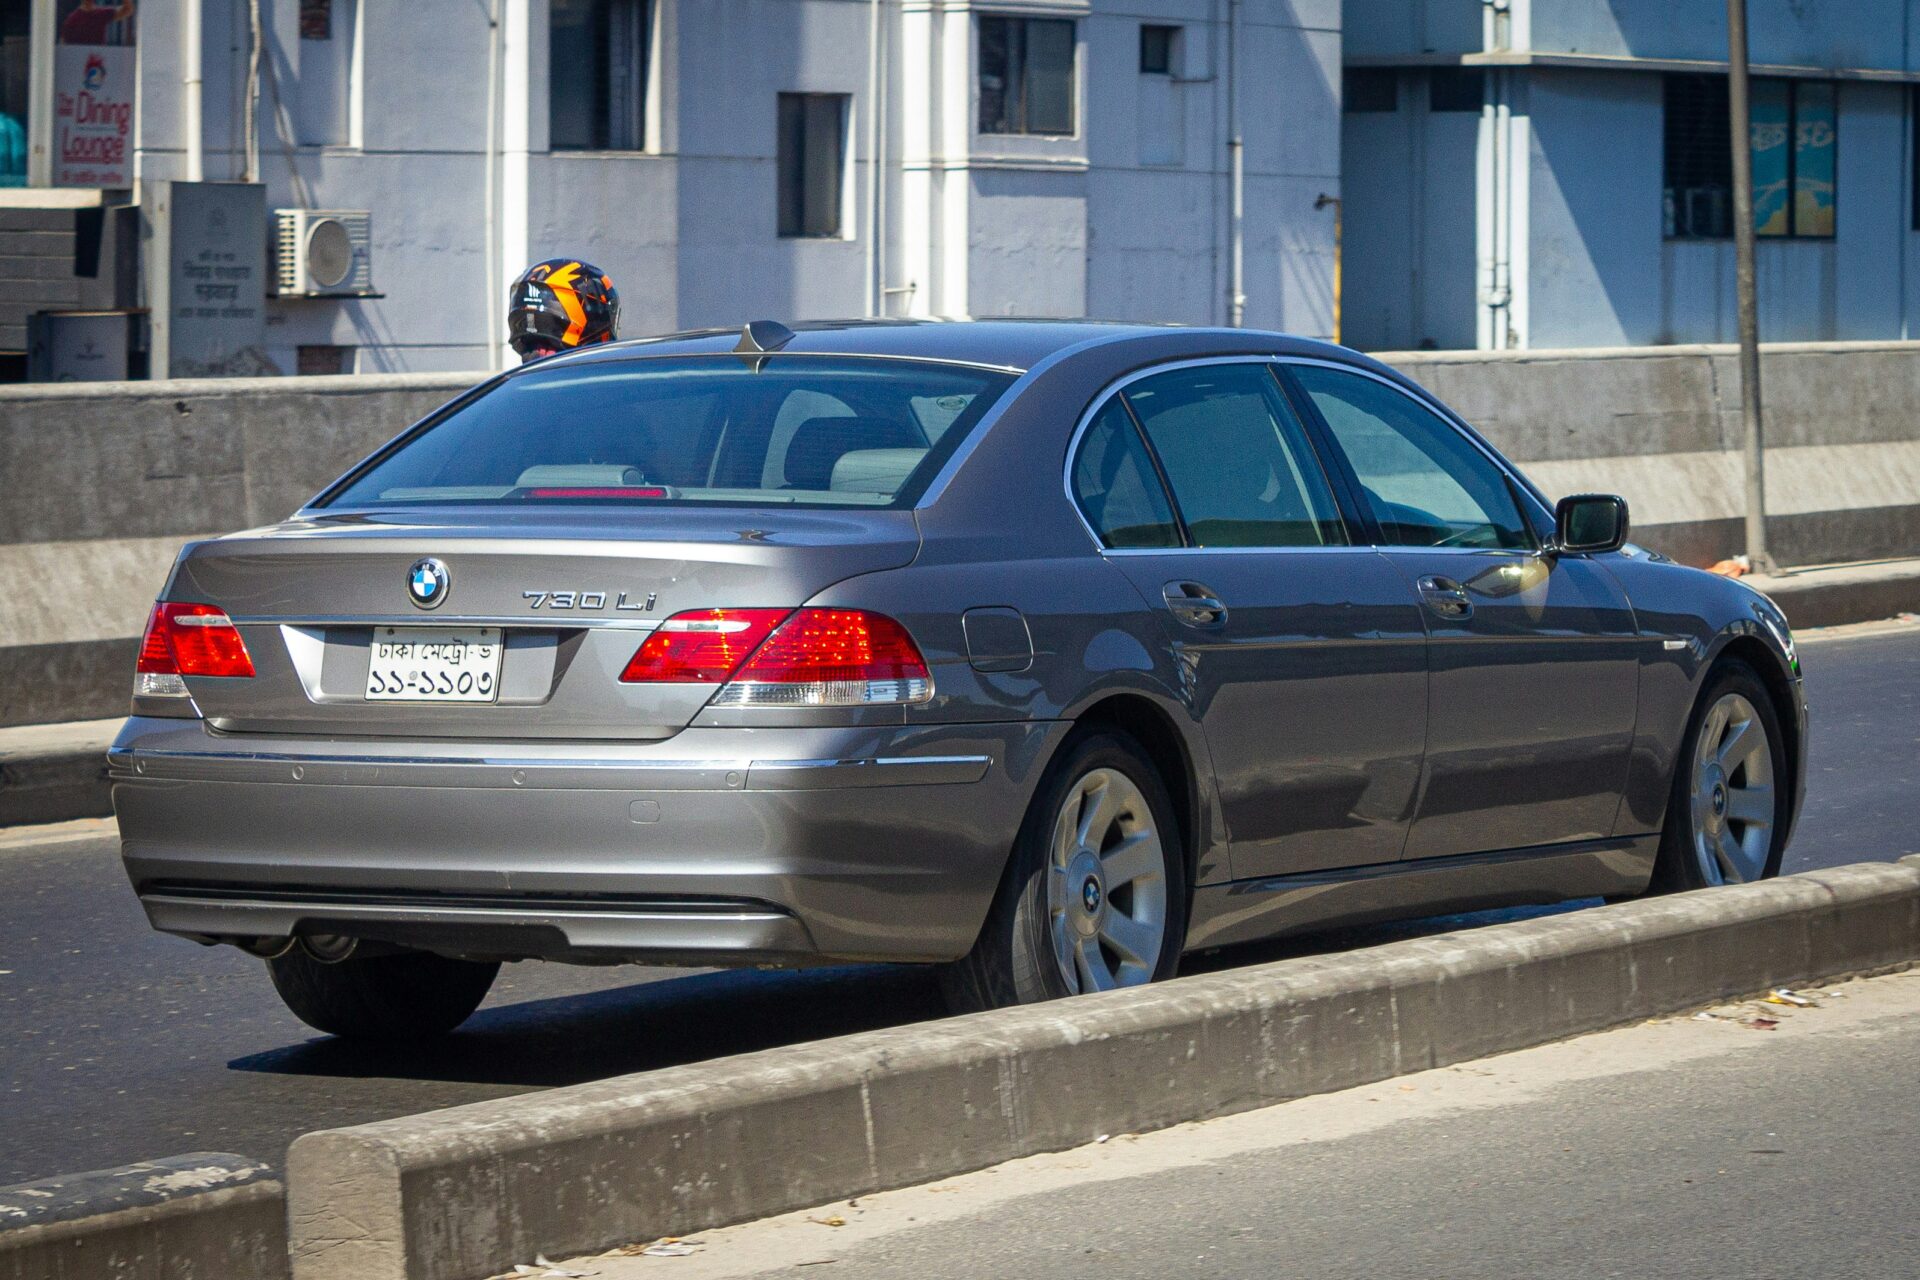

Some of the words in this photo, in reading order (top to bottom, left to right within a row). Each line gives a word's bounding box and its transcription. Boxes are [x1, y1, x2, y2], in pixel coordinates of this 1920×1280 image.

[76, 91, 131, 135] Dining
[63, 126, 124, 164] Lounge
[522, 591, 607, 610] 730
[616, 591, 657, 611] Li
[378, 641, 417, 660] ঢাকা
[369, 670, 493, 695] ১১-১১০৩
